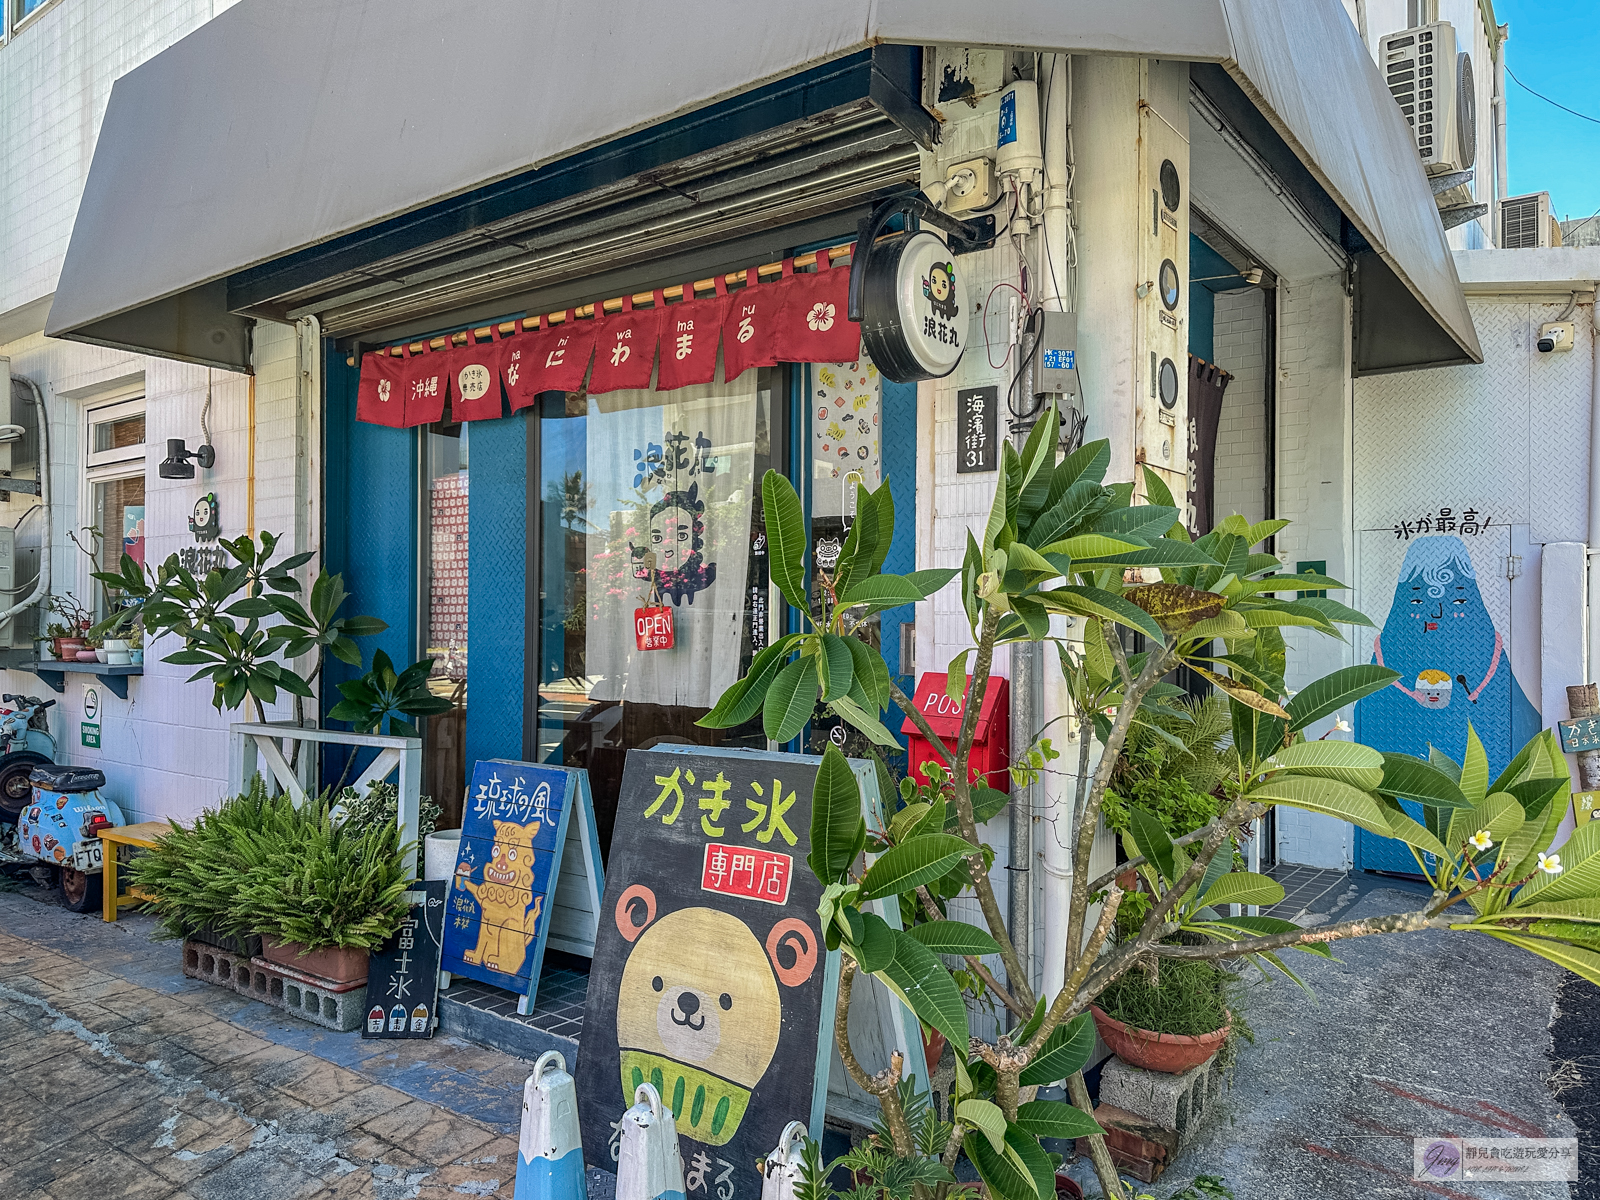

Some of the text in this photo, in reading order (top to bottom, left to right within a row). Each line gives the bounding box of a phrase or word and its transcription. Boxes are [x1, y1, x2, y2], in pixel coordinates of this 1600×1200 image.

[616, 328, 632, 341] wa
[676, 320, 694, 332] ma
[742, 304, 755, 317] ru
[923, 315, 960, 348] 浪花丸
[636, 614, 672, 636] OPEN
[922, 692, 968, 715] POS
[82, 725, 100, 736] SMOKING
[85, 734, 97, 744] AREA
[72, 804, 107, 813] Wilson
[473, 771, 556, 827] 琉球の風
[643, 766, 799, 847] かき氷
[708, 847, 785, 896] 専門店
